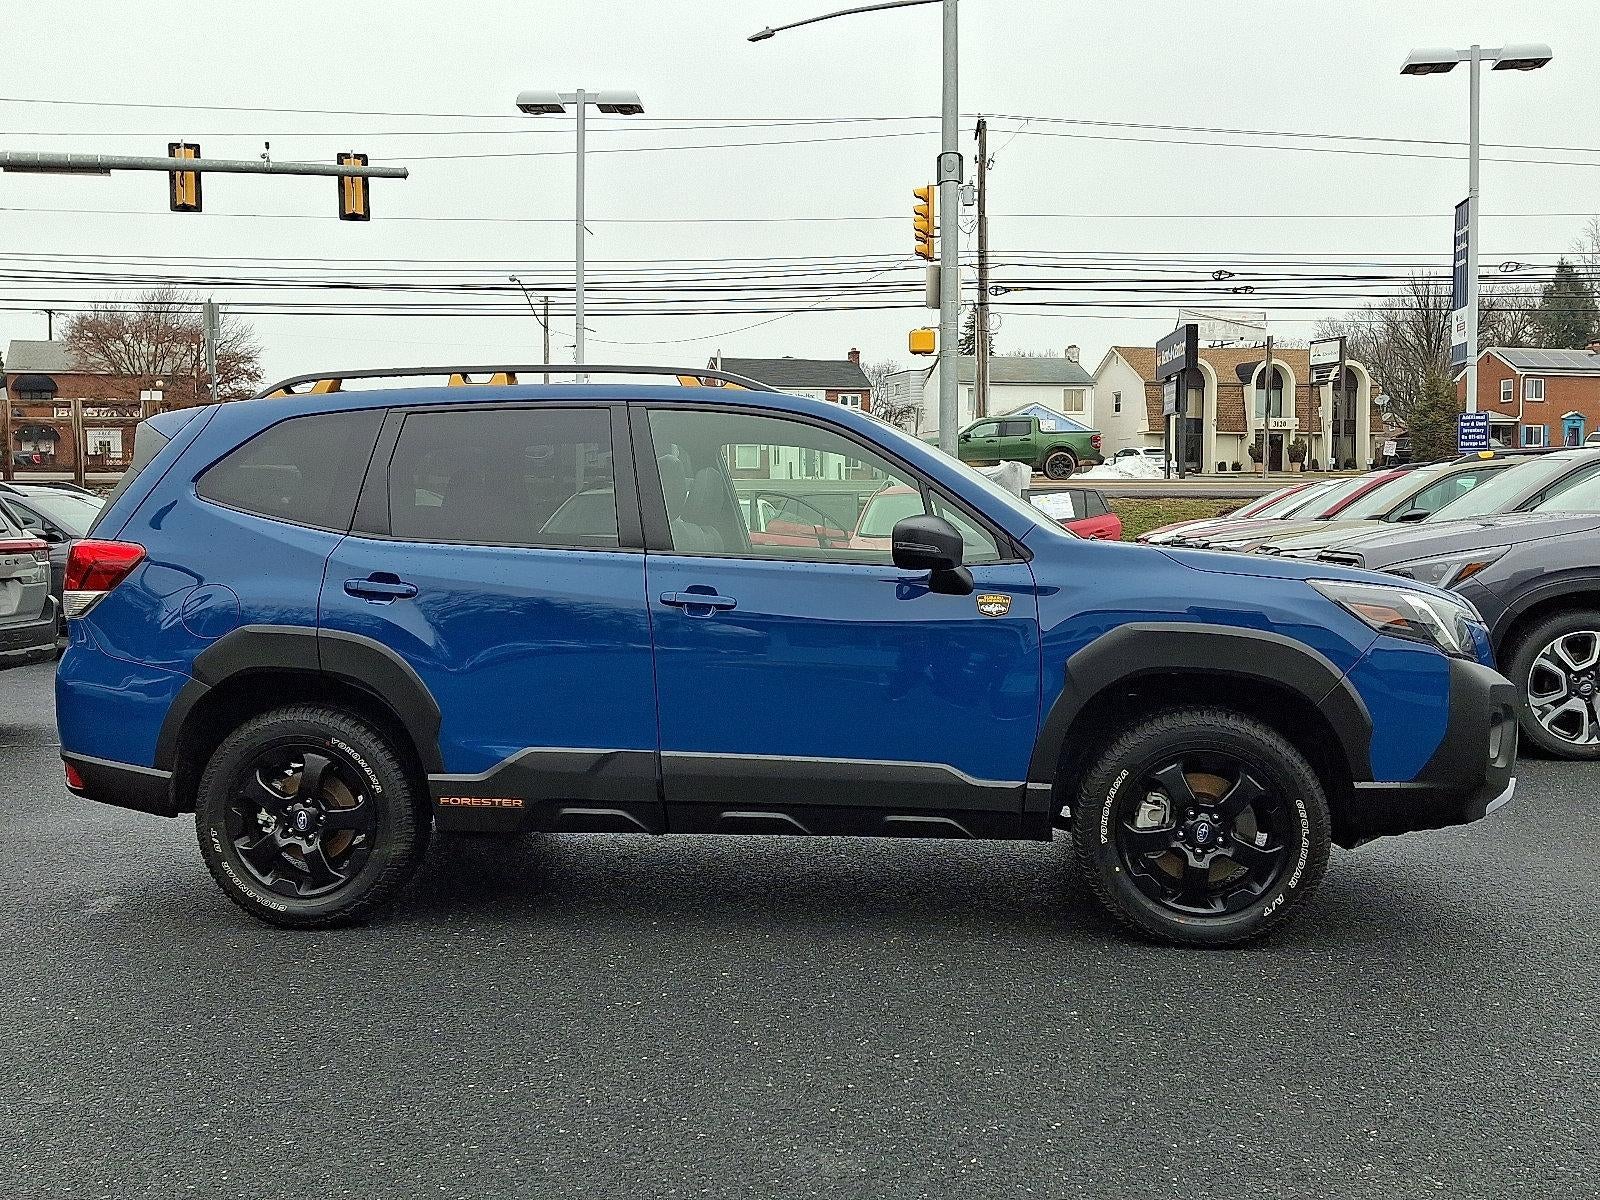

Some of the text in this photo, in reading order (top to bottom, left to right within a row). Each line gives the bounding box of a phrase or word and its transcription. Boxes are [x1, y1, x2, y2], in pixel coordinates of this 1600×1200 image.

[331, 737, 383, 794] YOKOHAMA
[439, 797, 523, 807] FORESTER
[1101, 769, 1129, 844] YOKOHAMA
[221, 861, 288, 912] GEOLANDAR
[1263, 799, 1310, 917] GEOLANDAR A/T
